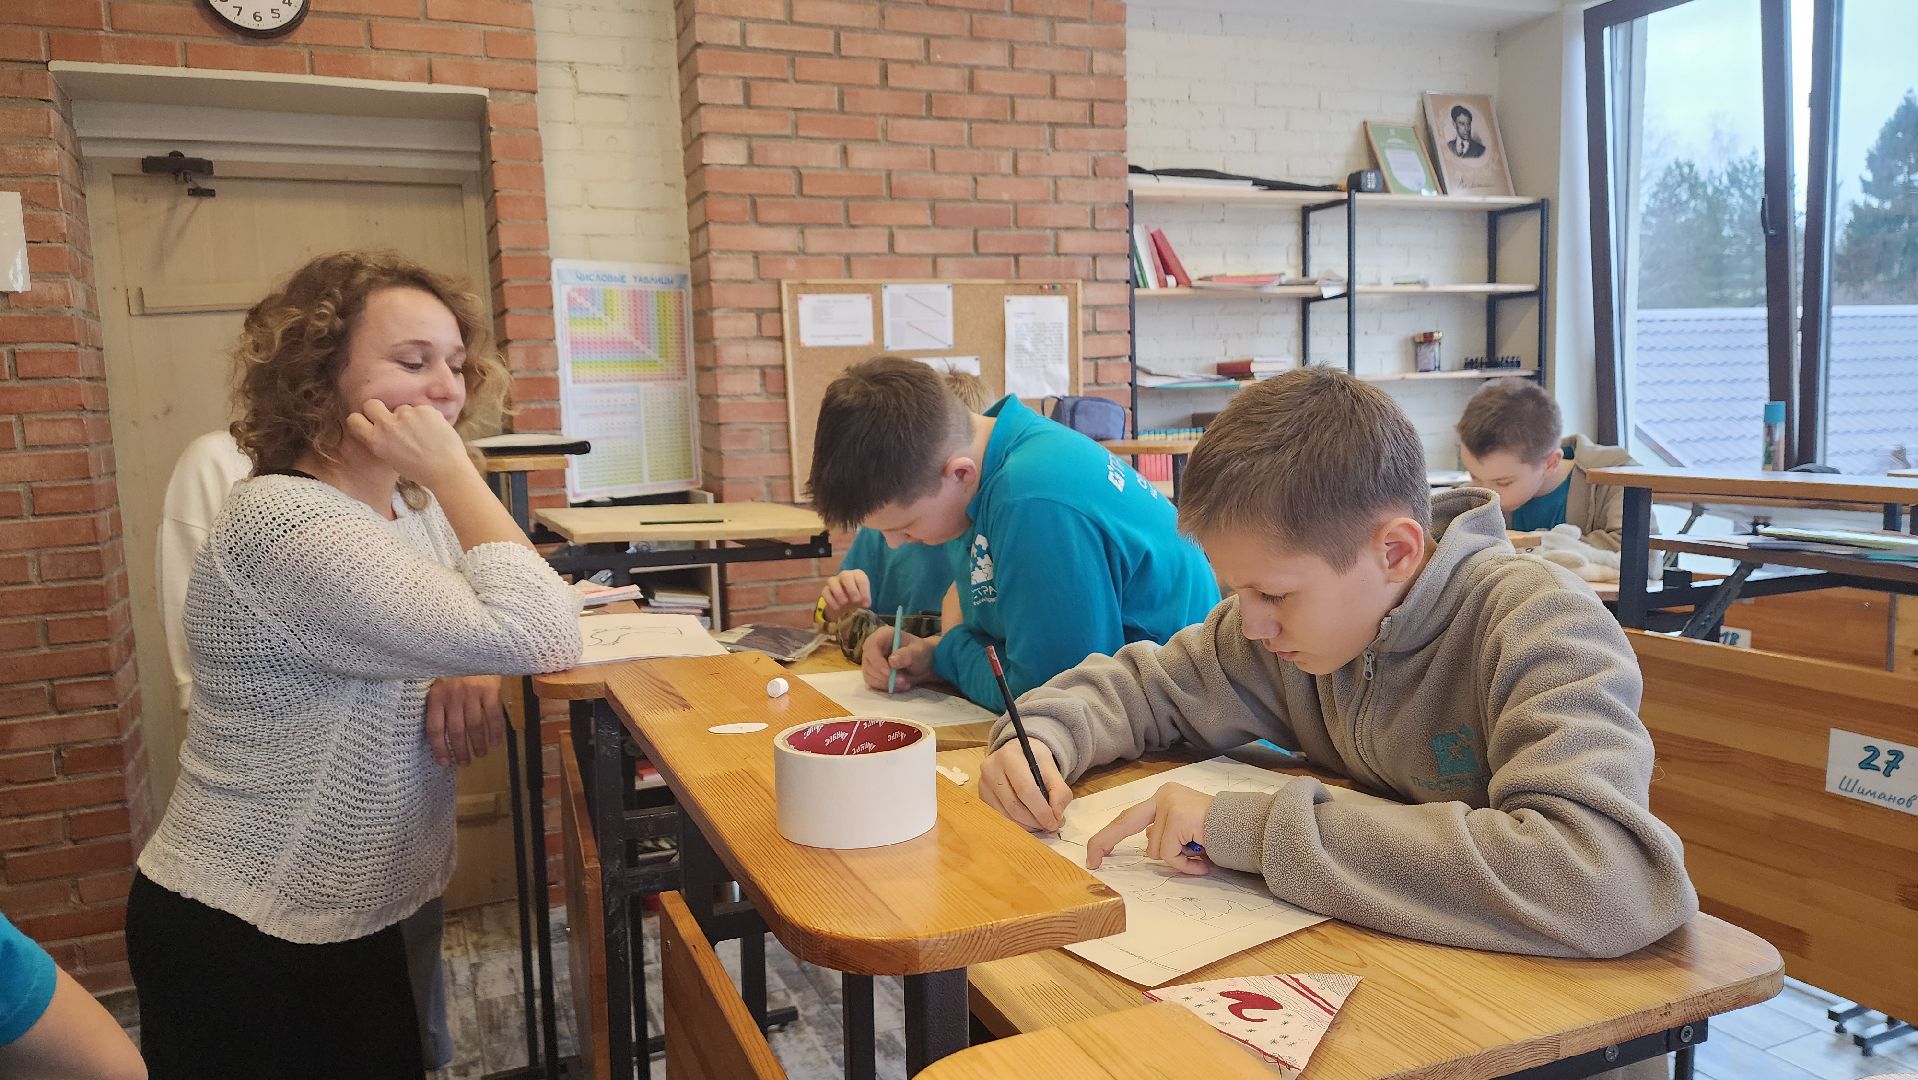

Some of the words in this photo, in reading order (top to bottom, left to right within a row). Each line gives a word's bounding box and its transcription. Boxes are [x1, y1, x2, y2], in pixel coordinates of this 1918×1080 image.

[232, 5, 243, 16] 7
[270, 8, 281, 18] 5
[252, 11, 263, 22] 6
[1858, 744, 1905, 778] 27
[1838, 775, 1918, 809] Шиманов
